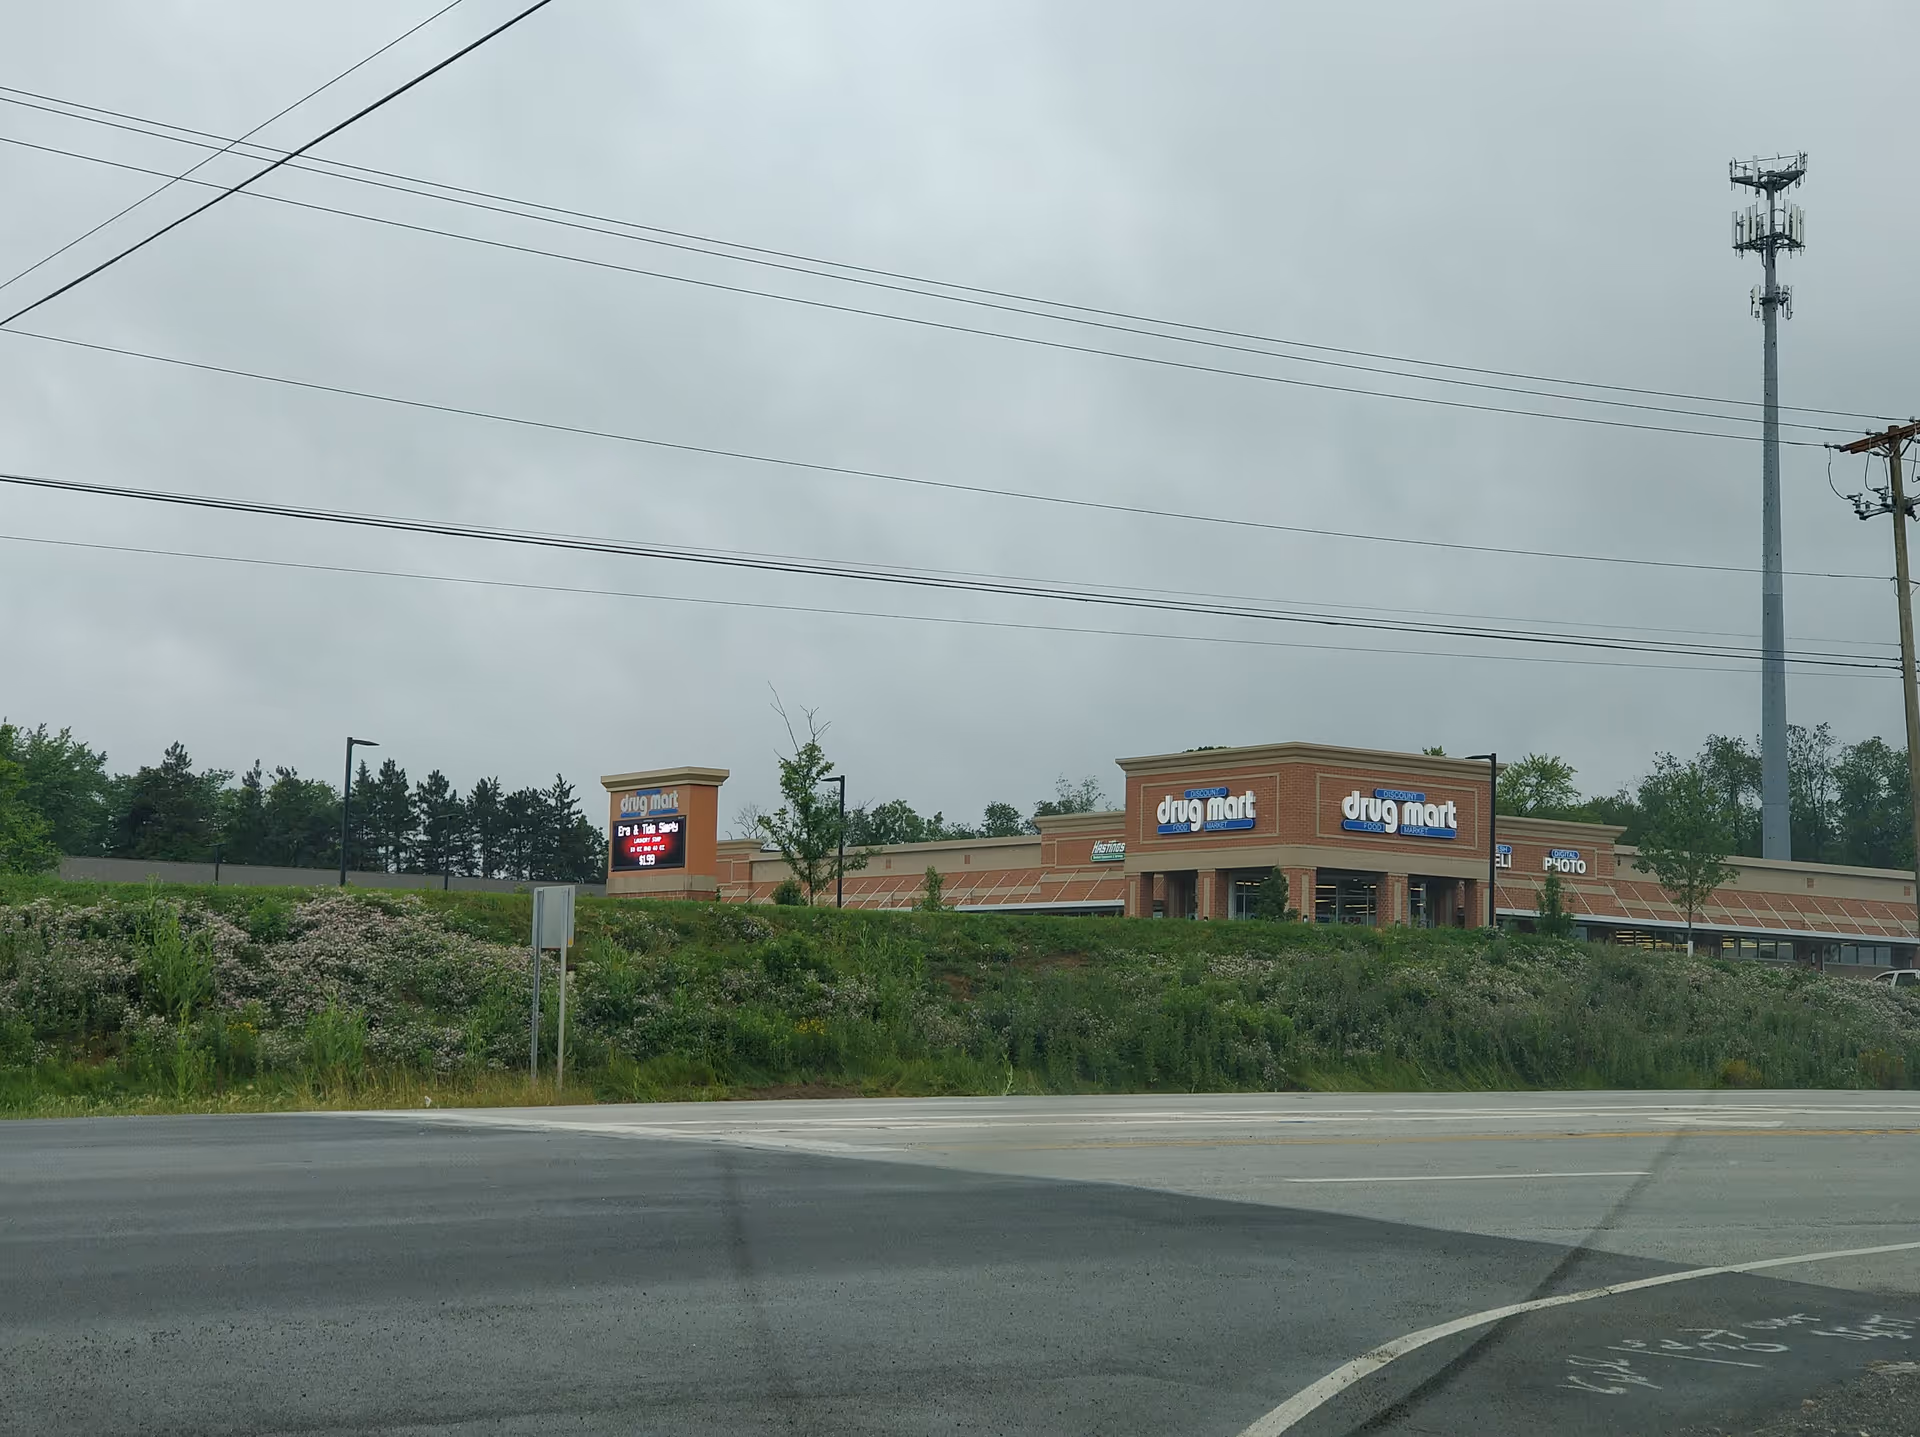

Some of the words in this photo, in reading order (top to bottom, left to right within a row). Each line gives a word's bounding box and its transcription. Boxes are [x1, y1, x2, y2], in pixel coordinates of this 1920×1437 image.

[1190, 788, 1220, 798] DISCOUNT
[1383, 790, 1417, 800] DISCOUNT
[621, 794, 647, 816] drug
[651, 791, 678, 810] mart
[1157, 795, 1204, 832] drug
[1207, 790, 1256, 821] mart
[1341, 790, 1398, 834] drug
[1401, 800, 1457, 829] mart
[618, 826, 631, 837] Era
[1172, 824, 1188, 832] FOOD
[1206, 821, 1228, 829] MARKET
[1363, 822, 1382, 831] FOOD
[1403, 826, 1428, 835] MARKET
[639, 854, 655, 866] $1.99
[1495, 853, 1511, 868] ELI
[1554, 851, 1576, 859] DIGITAL
[1543, 856, 1587, 874] PHOTO
